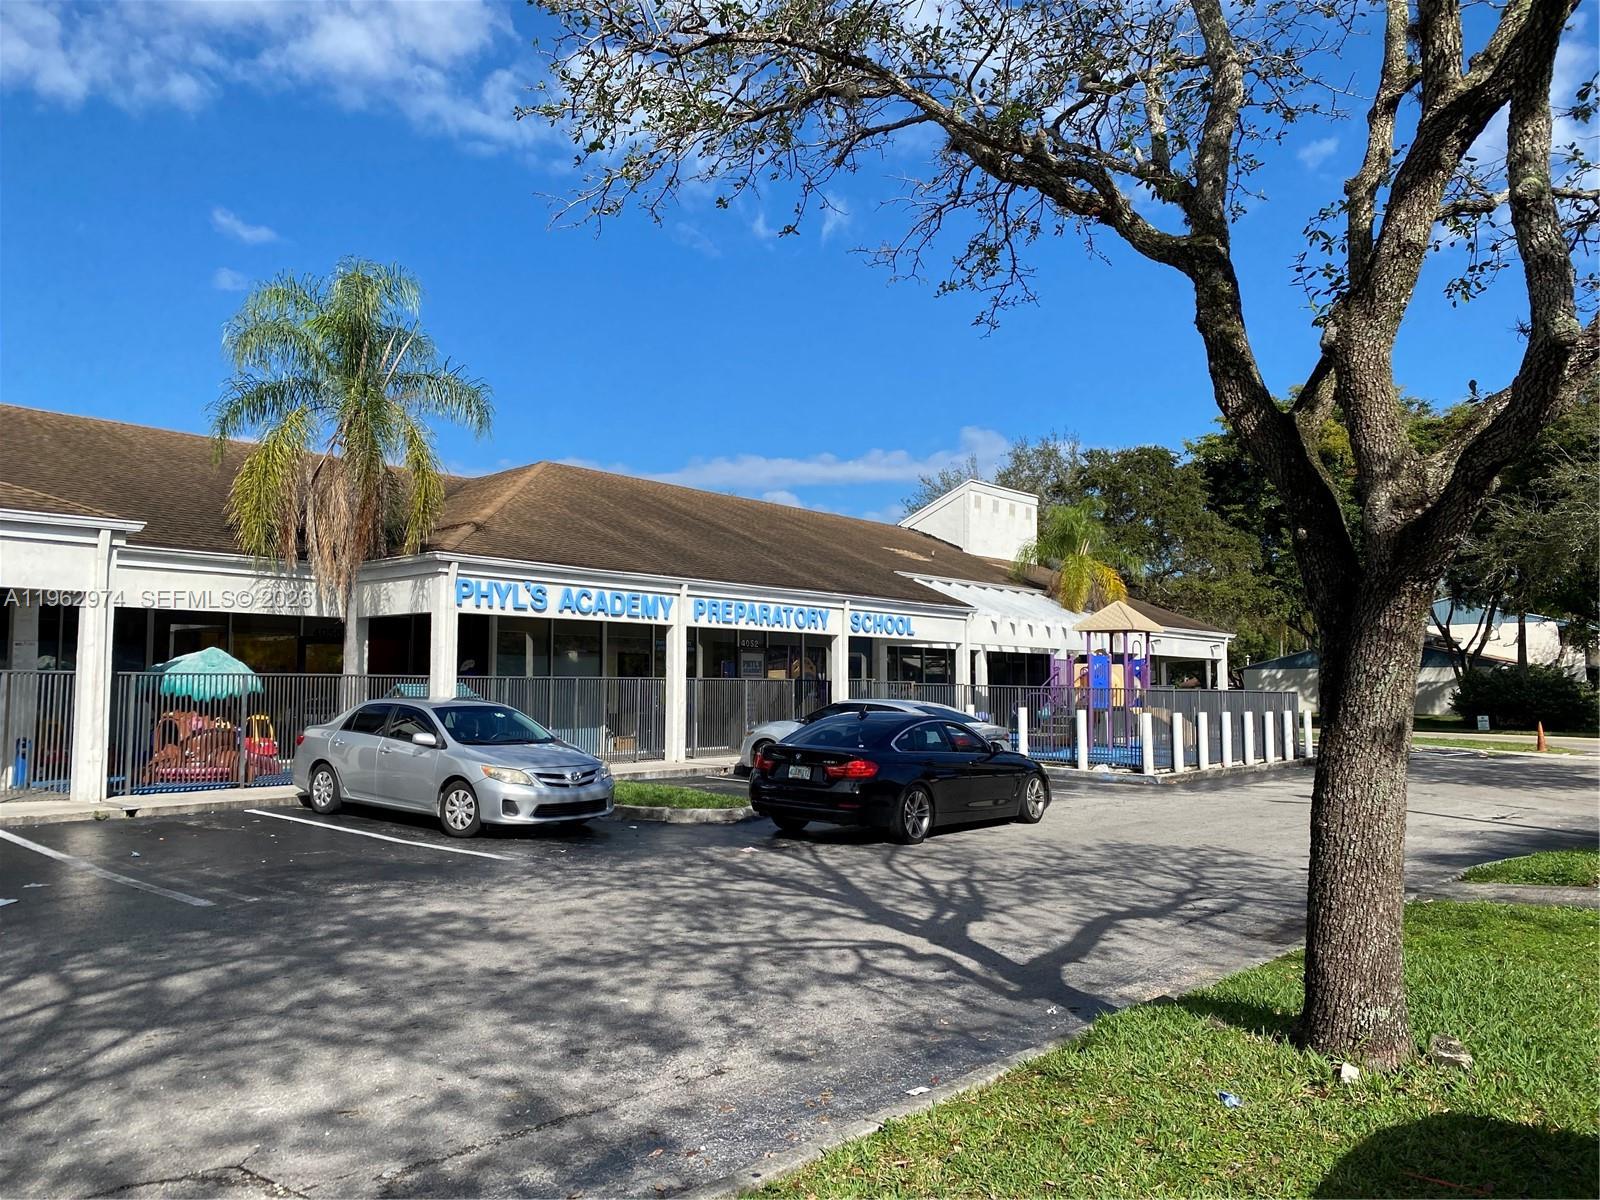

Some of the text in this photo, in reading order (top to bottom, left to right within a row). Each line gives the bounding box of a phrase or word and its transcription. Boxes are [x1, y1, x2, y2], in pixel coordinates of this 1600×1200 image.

[456, 578, 915, 636] PHYL'S ACADEMY PREPARATORY SCHOOL
